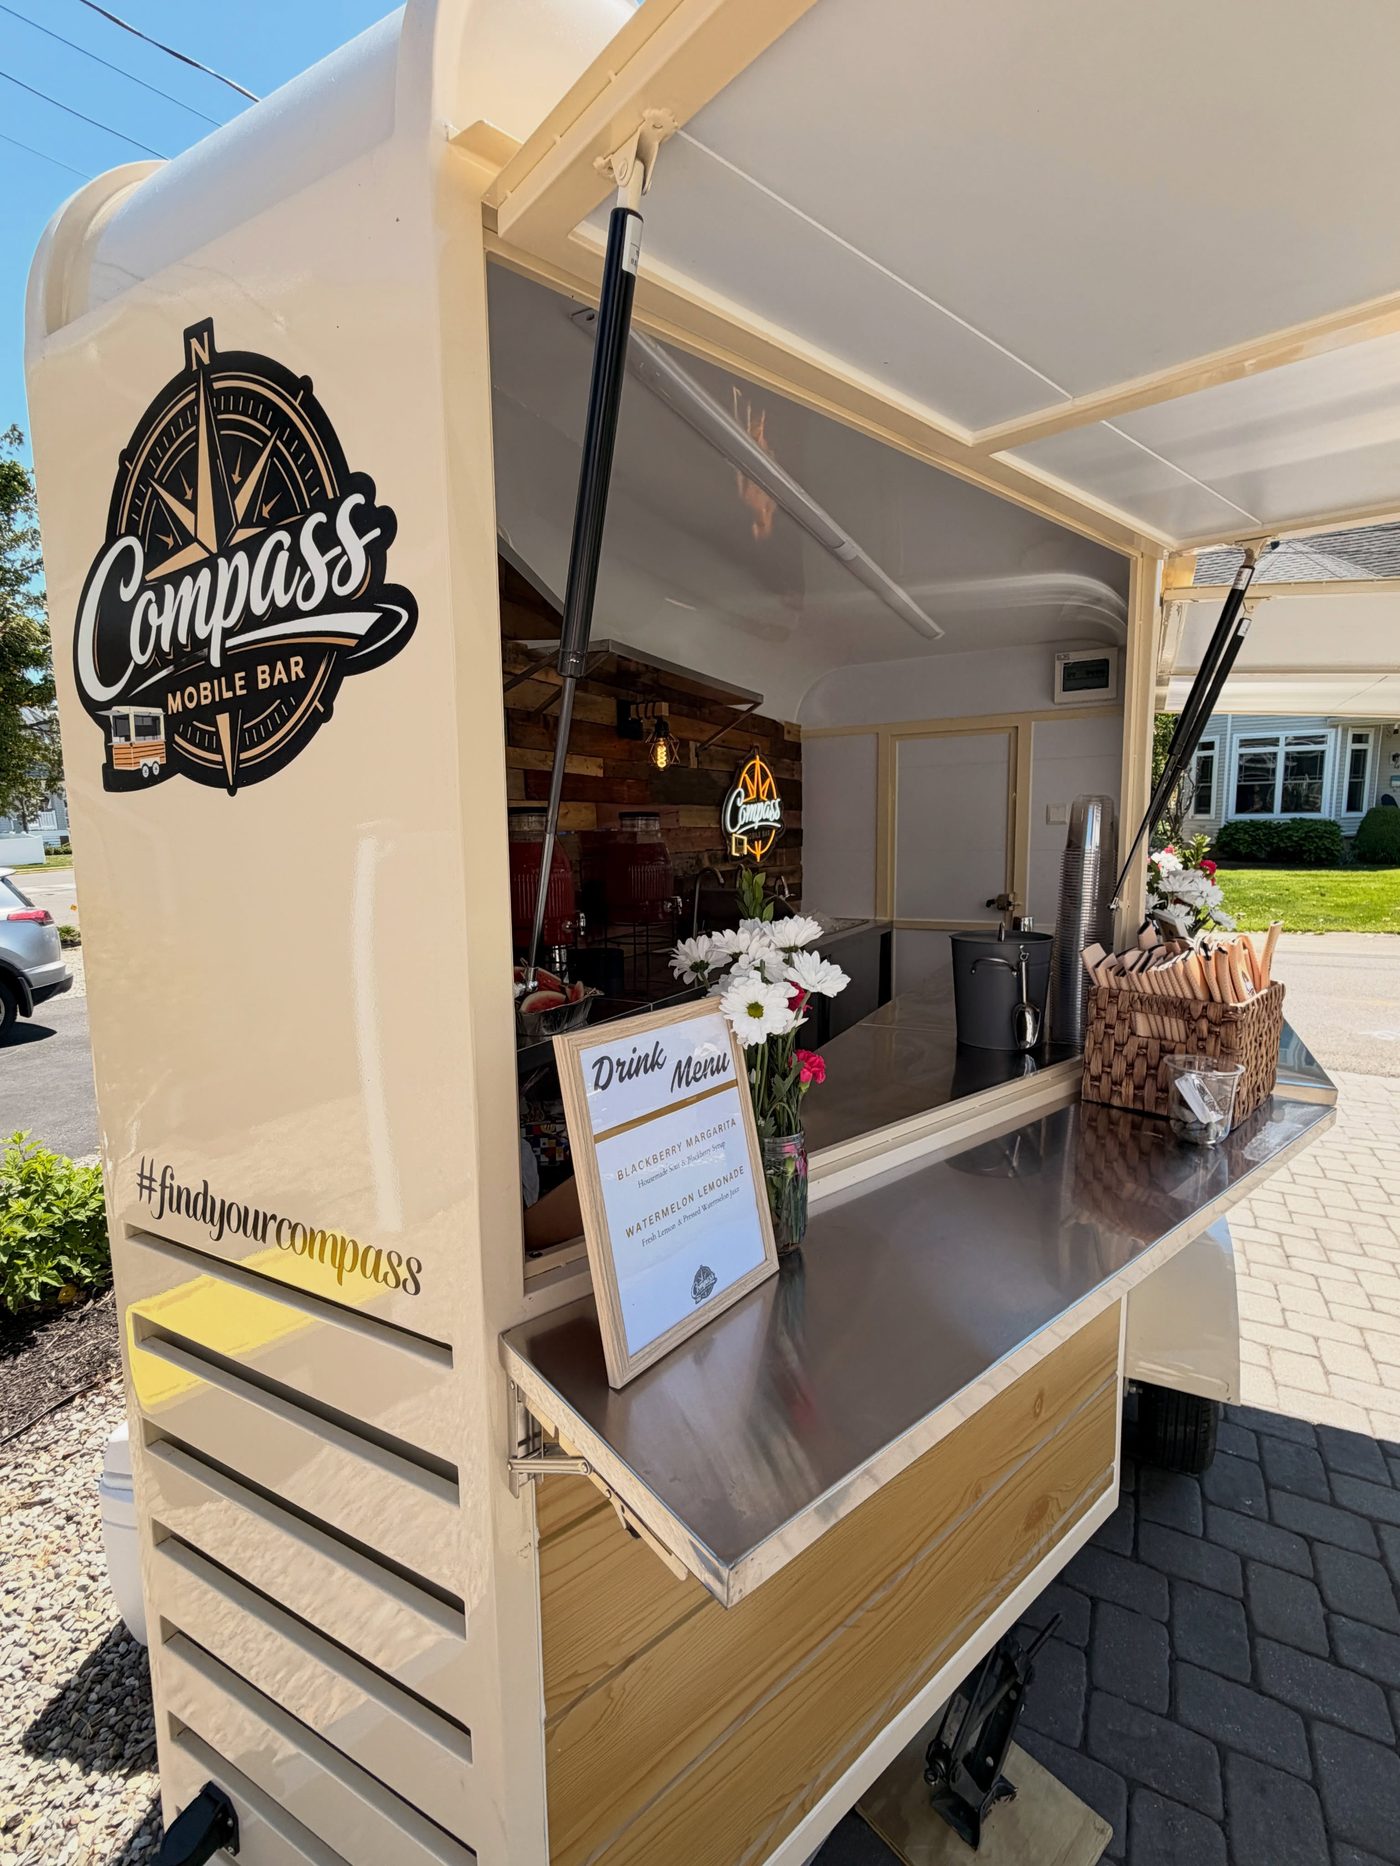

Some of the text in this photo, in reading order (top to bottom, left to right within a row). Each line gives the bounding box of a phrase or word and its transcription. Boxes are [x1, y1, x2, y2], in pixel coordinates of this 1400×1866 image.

[189, 332, 211, 371] N
[77, 493, 381, 701] Compass
[167, 656, 306, 715] MOBILE BAR
[725, 788, 781, 833] Compass
[592, 1041, 730, 1093] Drink Menu
[617, 1118, 737, 1181] BLACKBERRY MARGARITA
[136, 1155, 423, 1296] #findyourcompass
[625, 1165, 745, 1238] WATERMELON LEMONADE
[641, 1231, 657, 1247] Fresh
[657, 1222, 677, 1238] Lemon
[682, 1206, 701, 1222] Pressed
[701, 1192, 729, 1212] Watermelon
